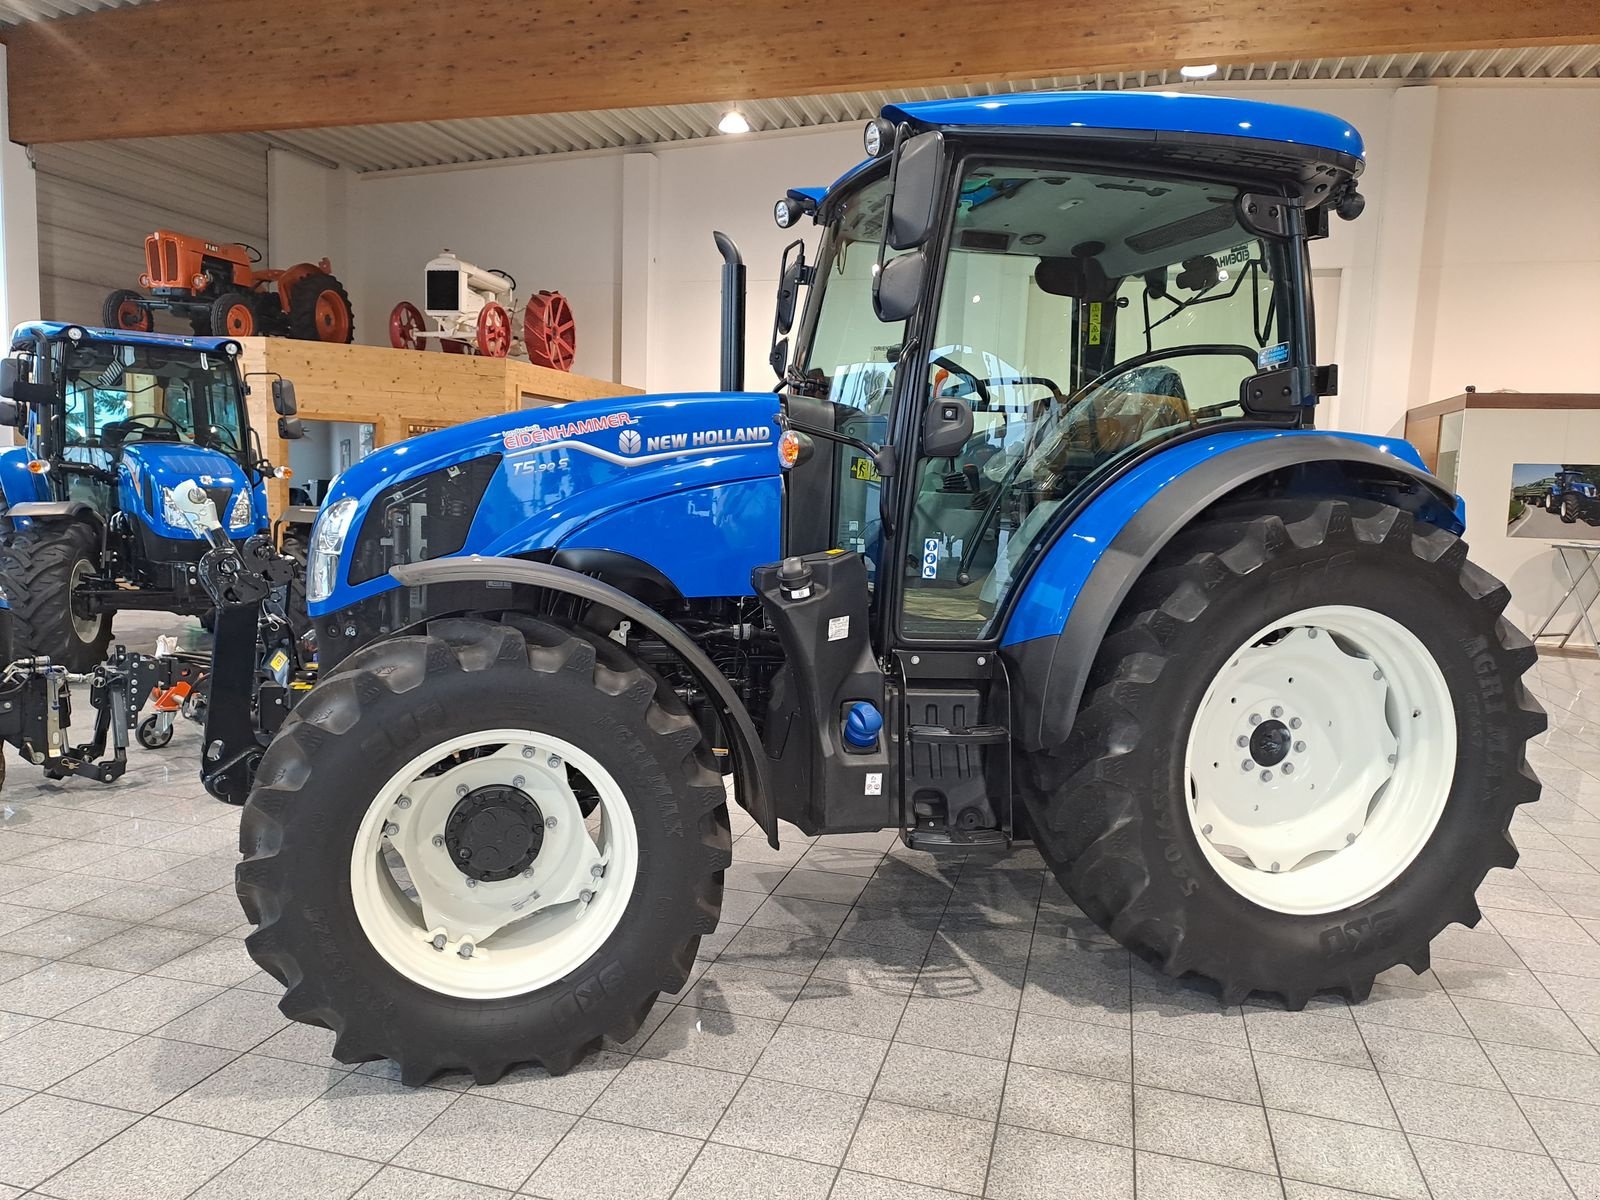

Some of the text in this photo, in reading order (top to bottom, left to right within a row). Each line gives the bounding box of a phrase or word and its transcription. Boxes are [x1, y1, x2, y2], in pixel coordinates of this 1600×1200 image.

[503, 411, 632, 450] EIDENHAMMER
[647, 426, 770, 451] NEW HOLLAND
